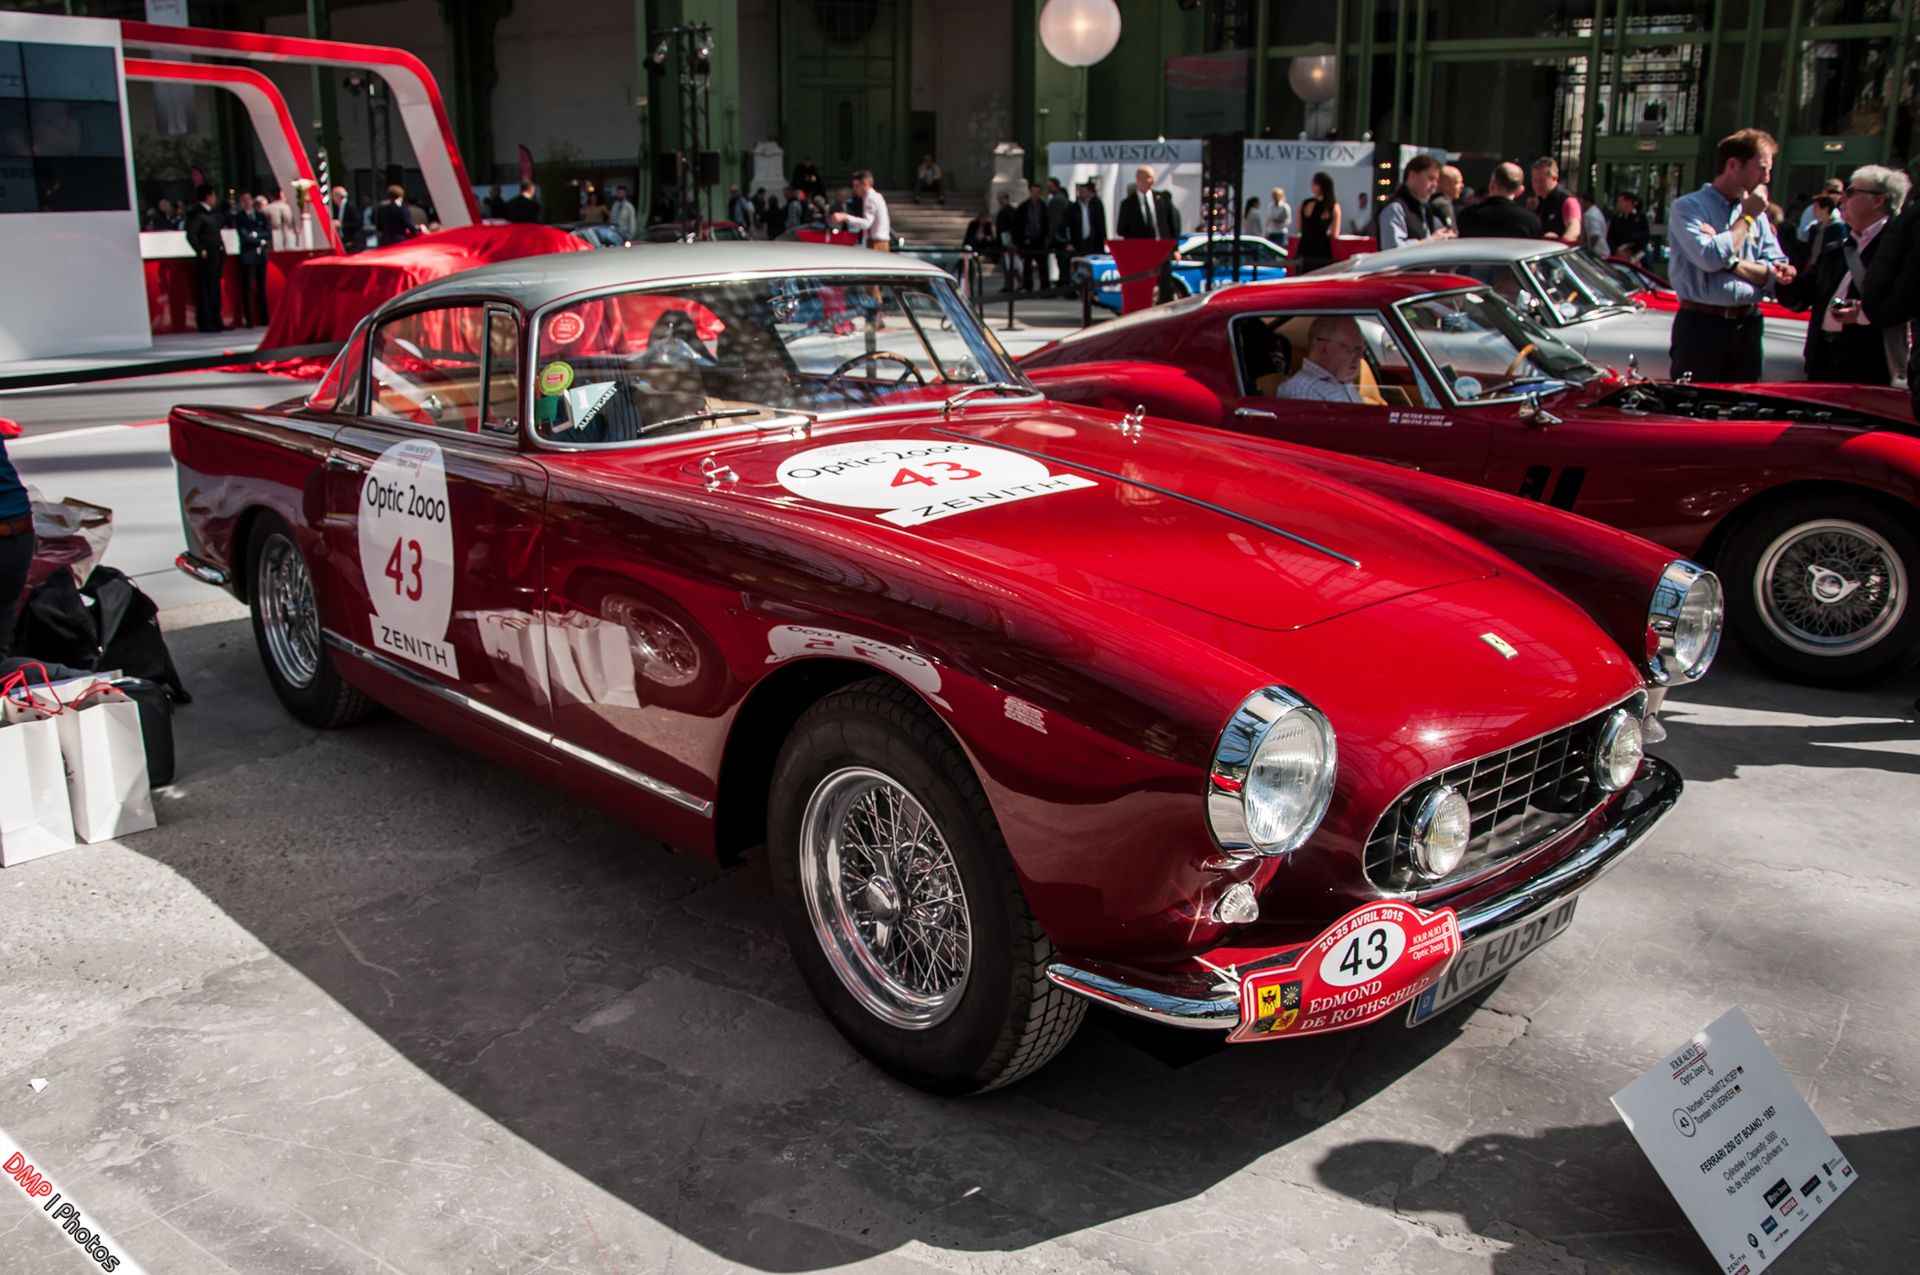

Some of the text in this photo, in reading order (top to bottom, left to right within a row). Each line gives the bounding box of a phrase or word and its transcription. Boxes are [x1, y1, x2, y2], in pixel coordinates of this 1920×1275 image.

[1101, 144, 1180, 160] WESTON
[1275, 145, 1355, 161] WESTON
[787, 454, 886, 479] Optic
[883, 443, 970, 461] 2000
[890, 461, 982, 488] 43
[366, 476, 446, 523] Optic 2000
[912, 479, 1070, 517] ZENITH
[385, 536, 423, 601] 43
[381, 625, 448, 668] ZENITH
[1319, 909, 1404, 952] 20-25 AVRIL 2015
[1339, 928, 1388, 976] 43
[1412, 943, 1445, 960] Optic 2000
[1301, 977, 1429, 1030] DE ROTHSCHILD
[1308, 980, 1382, 1015] EDMOND
[1680, 1064, 1706, 1086] Optic 2000
[1686, 1069, 1738, 1113] Norbert SCHMITZ KOEP
[1679, 1116, 1690, 1128] 43
[1694, 1087, 1737, 1124] Torsten WUERKER
[1699, 1147, 1728, 1175] FERRARI
[1724, 1140, 1737, 1154] 250
[1733, 1133, 1744, 1146] GT
[1741, 1117, 1763, 1139] BOANO
[1763, 1105, 1777, 1120] 1957
[1734, 1179, 1743, 1190] de
[1740, 1162, 1761, 1185] cylindres
[1780, 1137, 1789, 1147] 12
[1726, 1253, 1747, 1274] ZENITH
